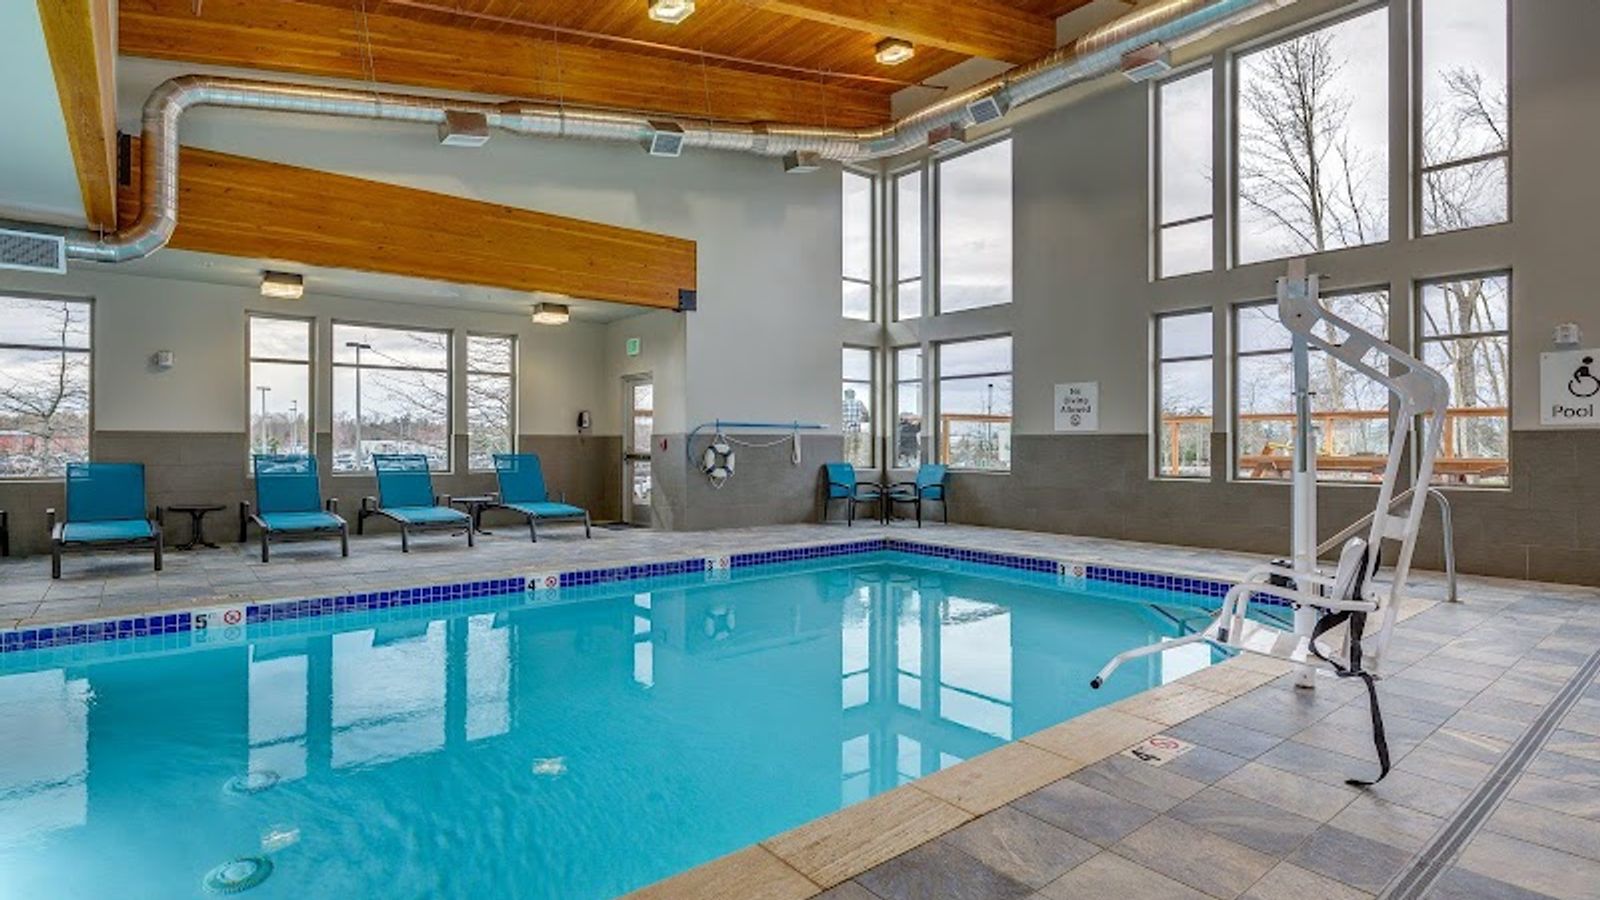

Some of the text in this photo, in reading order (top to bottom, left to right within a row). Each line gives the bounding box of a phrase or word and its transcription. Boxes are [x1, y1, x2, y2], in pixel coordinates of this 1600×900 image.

[1552, 404, 1593, 417] Pool
[528, 578, 535, 591] 4
[195, 614, 207, 629] 5
